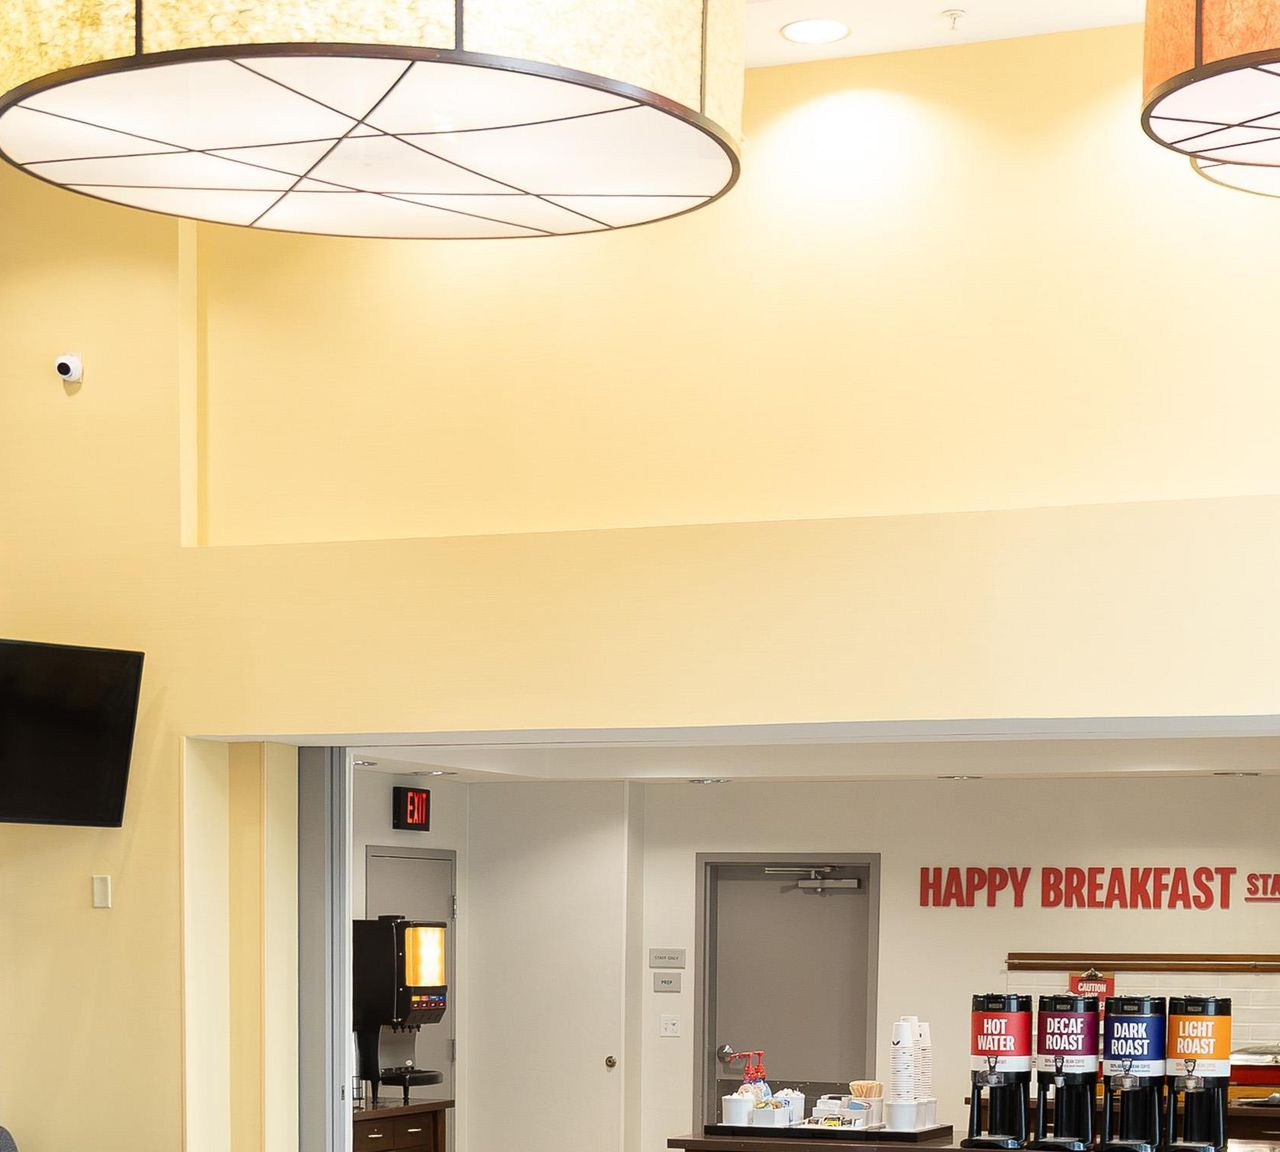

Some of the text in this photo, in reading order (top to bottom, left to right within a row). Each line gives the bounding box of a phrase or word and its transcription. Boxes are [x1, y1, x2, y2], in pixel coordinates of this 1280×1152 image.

[407, 791, 427, 824] EXIT
[920, 867, 1032, 907] HAPPY
[1041, 867, 1237, 910] BREAKFAST
[1077, 982, 1107, 993] CAUTION
[983, 1018, 1008, 1034] HOT
[1046, 1017, 1084, 1034] DECAF
[1113, 1022, 1148, 1038] DARK
[1179, 1021, 1215, 1037] LIGHT
[977, 1035, 1015, 1051] WATER
[1045, 1034, 1085, 1051] ROAST
[1111, 1039, 1150, 1055] ROAST
[1176, 1038, 1216, 1054] ROAST
